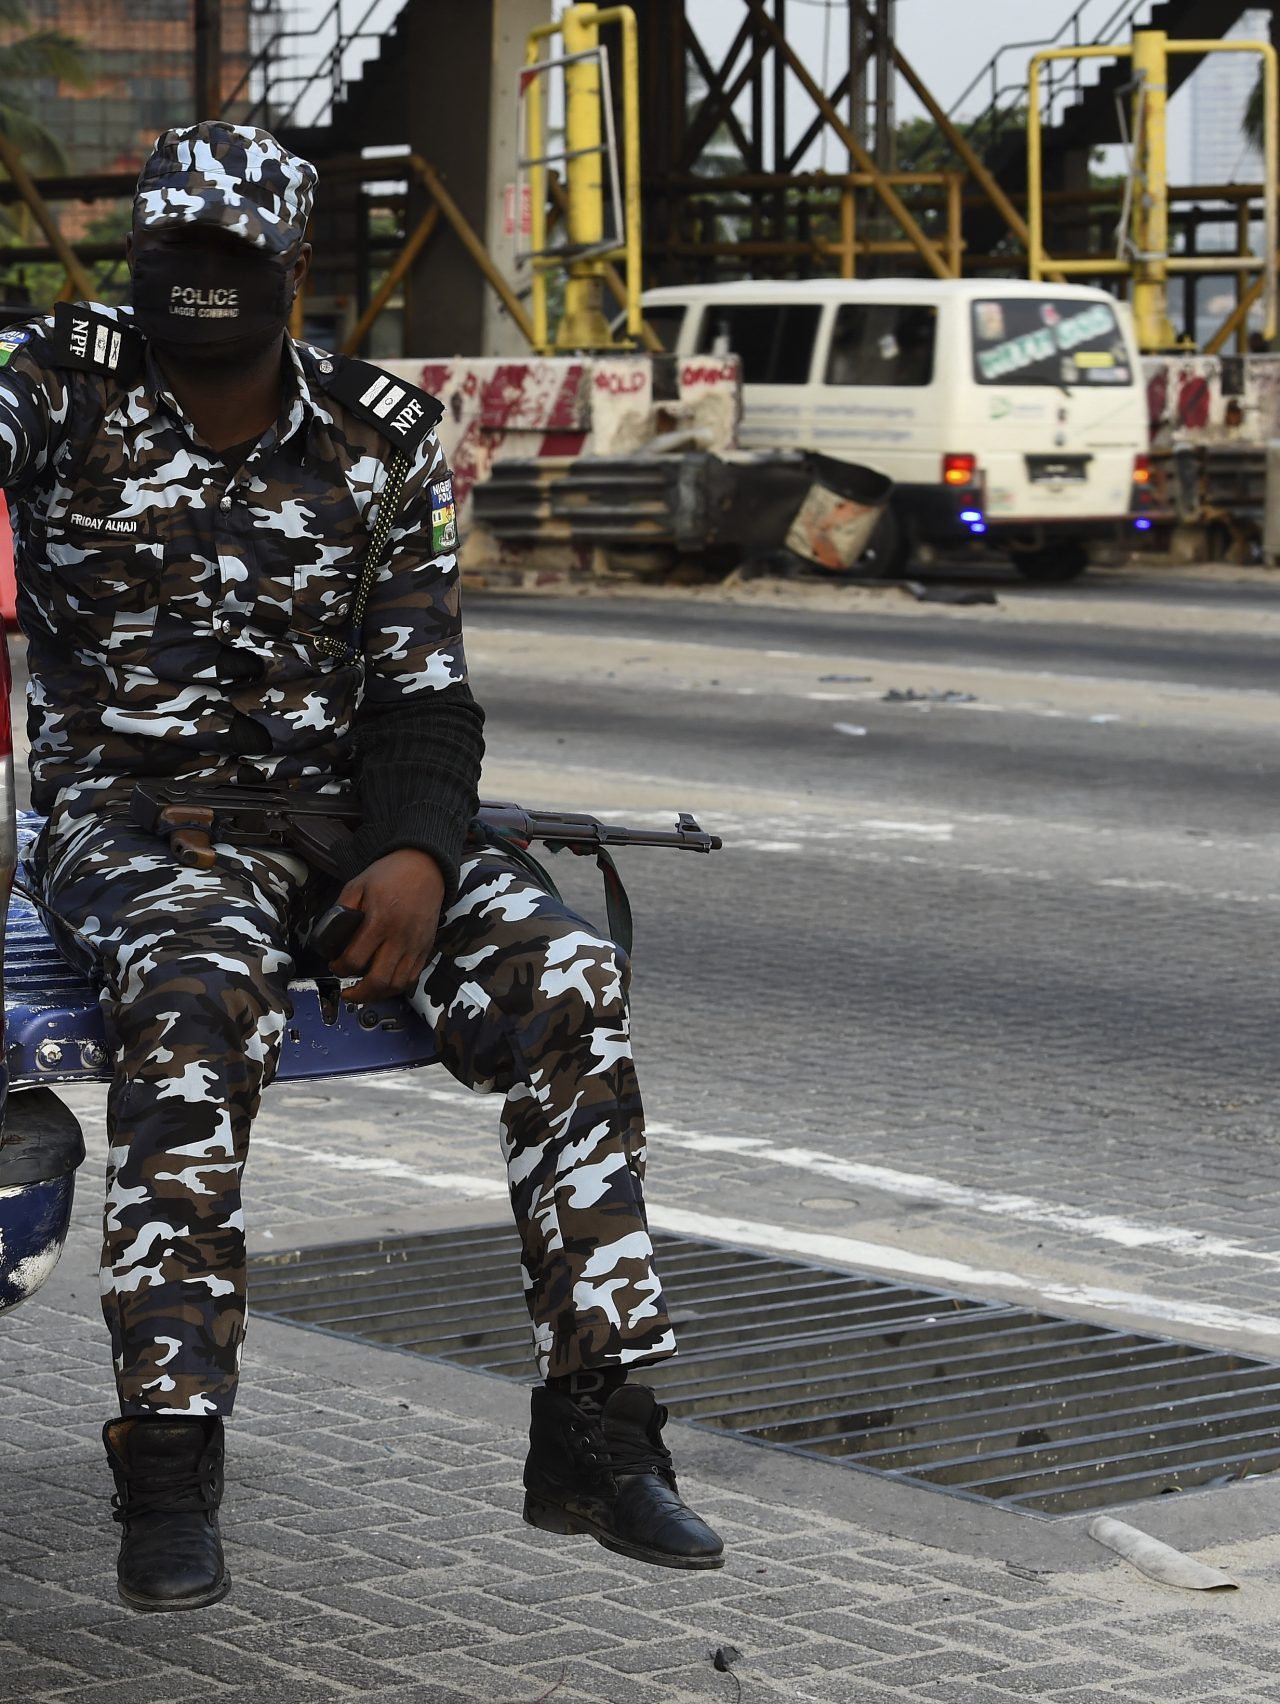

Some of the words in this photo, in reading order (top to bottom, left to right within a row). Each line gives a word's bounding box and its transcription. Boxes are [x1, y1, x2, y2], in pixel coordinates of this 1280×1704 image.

[171, 286, 239, 305] POLICE
[70, 318, 89, 358] NPF
[390, 398, 425, 436] NPF
[71, 514, 103, 530] FRIDAY
[105, 520, 137, 532] ALHAJI
